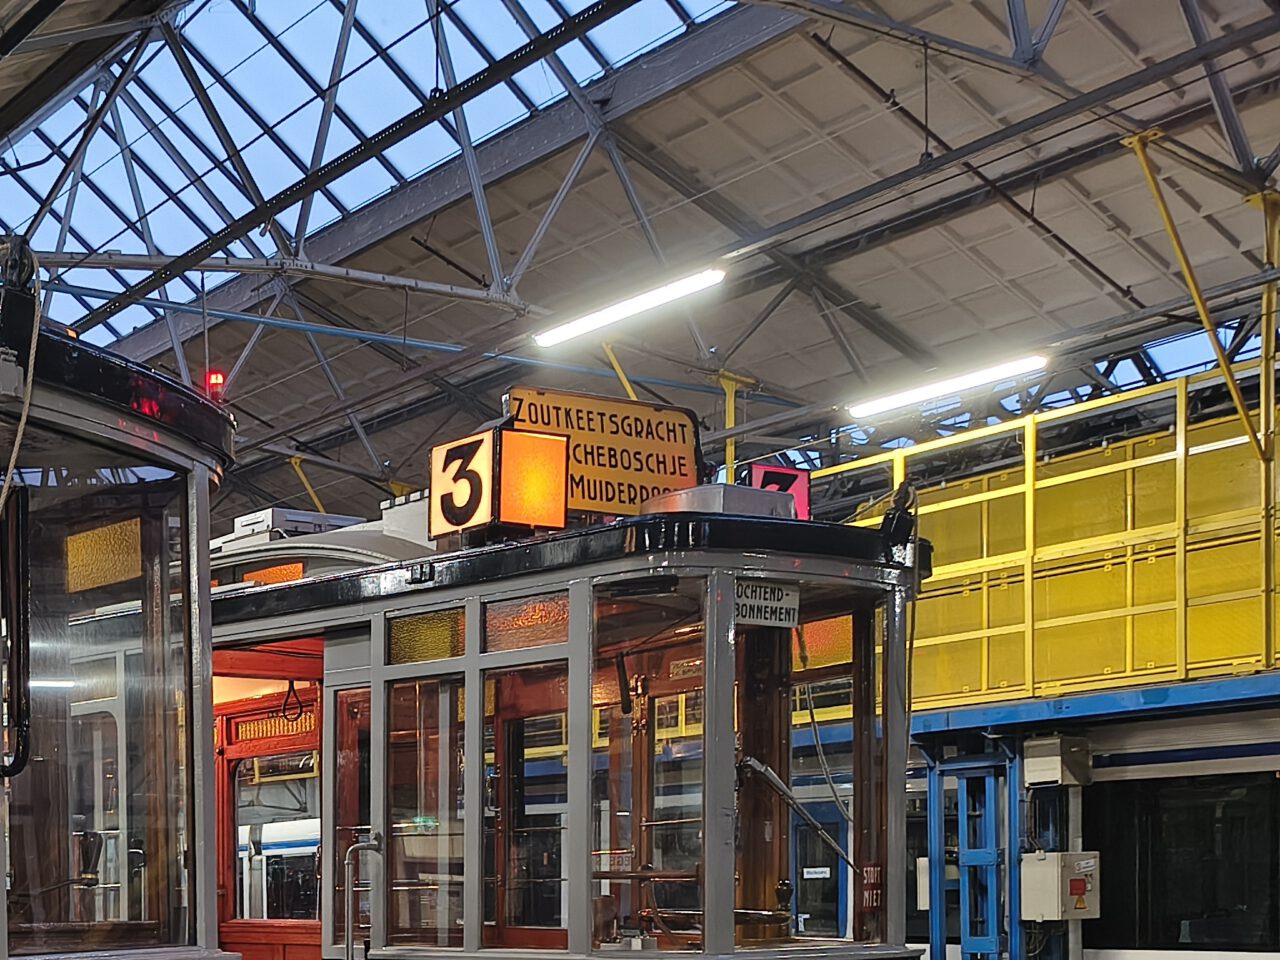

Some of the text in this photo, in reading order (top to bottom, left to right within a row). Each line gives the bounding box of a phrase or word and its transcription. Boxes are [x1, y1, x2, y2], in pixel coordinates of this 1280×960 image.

[513, 398, 688, 445] ZOUTKEETSGRACHT
[568, 443, 688, 477] CHEBOSCHJE
[441, 438, 484, 527] 3
[736, 583, 790, 602] OCHTEND-
